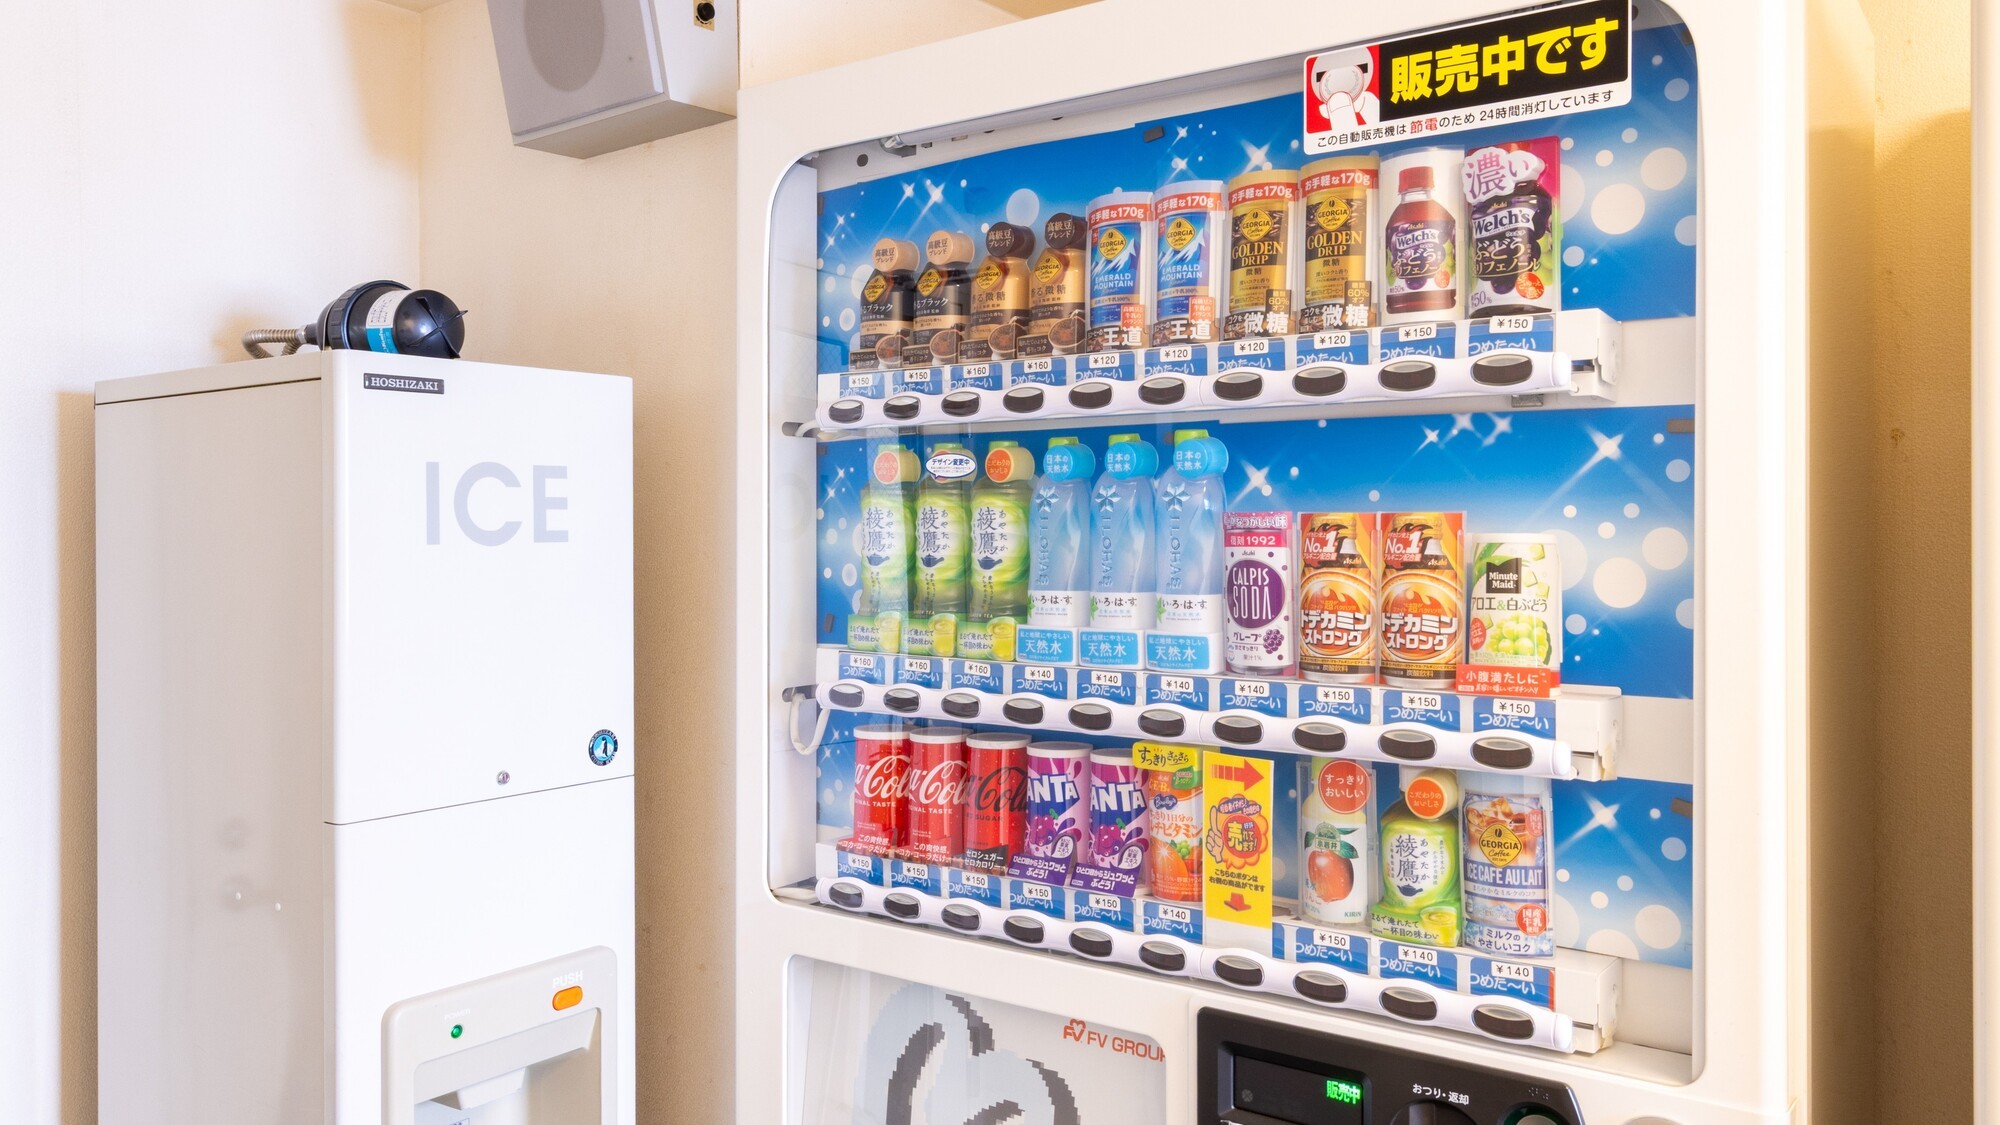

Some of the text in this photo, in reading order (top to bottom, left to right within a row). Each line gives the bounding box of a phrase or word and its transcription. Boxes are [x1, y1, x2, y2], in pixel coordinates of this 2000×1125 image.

[1390, 17, 1619, 104] 販売中です
[1317, 124, 1407, 148] この自動販売機は
[1480, 90, 1614, 122] 24時間消灯しています
[1305, 173, 1370, 190] お手軽な170g
[1465, 152, 1530, 199] 濃い
[1231, 186, 1293, 203] お手軽な170g
[1157, 195, 1214, 213] お手軽な170g
[1090, 206, 1144, 223] お手軽な170g
[1317, 208, 1348, 218] GEORGIA
[1242, 219, 1270, 229] GEORGIA
[1473, 209, 1531, 233] Welch's
[1167, 229, 1193, 239] GEORGIA
[1307, 230, 1363, 250] GOLDEN
[1396, 230, 1436, 247] Welch's
[1100, 239, 1125, 248] GEORGIA
[1475, 237, 1526, 261] ぶどう
[1232, 241, 1284, 260] GOLDEN
[1317, 245, 1347, 257] DRIP
[1241, 255, 1268, 267] DRIP
[1322, 257, 1340, 267] 微糖
[1162, 265, 1201, 274] EMERALD
[1095, 273, 1131, 283] EMERALD
[1160, 272, 1202, 282] MOUNTAIN
[1094, 280, 1134, 290] MOUNTAIN
[1348, 288, 1370, 297] 60%
[1268, 297, 1290, 305] 60%
[1322, 304, 1369, 327] 微糖
[1244, 311, 1289, 334] 微糖
[1497, 318, 1528, 329] ¥150
[1170, 319, 1211, 340] 王道
[1404, 326, 1432, 338] ¥150
[1103, 326, 1143, 346] 王道
[1319, 335, 1346, 345] ¥120
[1239, 341, 1265, 352] ¥120
[1164, 349, 1188, 358] ¥120
[1027, 361, 1049, 370] ¥160
[1092, 355, 1116, 365] ¥120
[909, 371, 928, 380] ¥150
[966, 366, 987, 376] ¥160
[371, 377, 439, 391] HOSHIZAKI
[851, 377, 870, 386] ¥150
[1046, 454, 1068, 464] 日本の
[1107, 453, 1130, 463] 日本の
[1175, 450, 1201, 461] 日本の
[931, 458, 970, 466] デザイン変更中
[1046, 463, 1069, 473] 天然水
[1107, 462, 1131, 472] 天然水
[1175, 460, 1202, 471] 天然水
[426, 461, 569, 547] ICE
[866, 507, 887, 552] 綾鷹
[885, 509, 895, 550] あやたか
[920, 506, 943, 555] 綾鷹
[940, 508, 951, 551] あやたか
[977, 506, 999, 555] 綾鷹
[998, 509, 1009, 552] あやたか
[1247, 535, 1276, 545] 1992
[1304, 530, 1337, 552] No.1
[1385, 531, 1421, 554] No.1
[1232, 567, 1270, 586] CALPIS
[1489, 571, 1518, 581] Minute
[1492, 580, 1515, 589] Maid
[1233, 585, 1272, 620] SODA
[1301, 610, 1372, 633] ドデカミン
[1381, 612, 1457, 635] ドデカミン
[1233, 631, 1262, 642] グレープ
[1305, 629, 1362, 647] ストロング
[1386, 633, 1448, 651] ストロング
[1025, 640, 1062, 655] 天然水
[1088, 642, 1127, 657] 天然水
[1155, 645, 1197, 662] 天然水
[853, 656, 872, 666] ¥160
[908, 661, 928, 671] ¥160
[968, 663, 988, 674] ¥160
[1030, 669, 1052, 679] ¥140
[1096, 674, 1119, 684] ¥140
[1466, 671, 1539, 685] 小腹満たしに
[1166, 680, 1190, 690] ¥140
[1239, 684, 1265, 695] ¥140
[1323, 690, 1350, 701] ¥150
[1408, 696, 1437, 707] ¥150
[1499, 702, 1530, 714] ¥150
[1138, 746, 1189, 767] すっきりさらさら
[1325, 773, 1364, 785] すっきり
[1325, 788, 1364, 799] おいしい
[1409, 791, 1442, 800] こだわりの
[1413, 800, 1440, 808] おいしさ
[1481, 839, 1520, 850] GEORGIA
[965, 849, 1004, 861] ゼロシュガー
[1395, 834, 1420, 884] 綾鷹
[1488, 849, 1511, 858] Coffee
[852, 857, 870, 868] ¥150
[964, 858, 1002, 870] ゼロカロリー
[1420, 839, 1430, 881] あやたか
[906, 866, 926, 877] ¥150
[1214, 868, 1259, 882] こちらのボタンは
[1505, 868, 1543, 886] AU LAIT
[965, 874, 986, 886] ¥150
[1090, 878, 1116, 891] ぶどう!
[1028, 887, 1049, 898] ¥150
[1095, 897, 1118, 908] ¥150
[1162, 908, 1187, 920] ¥140
[1371, 913, 1419, 929] まるで淹れたて
[1383, 926, 1440, 940] 一杯目の味わい
[1486, 928, 1521, 941] ミルクの
[1319, 932, 1347, 947] ¥150
[1478, 938, 1532, 953] やさしいコク
[1402, 948, 1433, 962] ¥140
[1496, 964, 1530, 978] ¥140
[552, 970, 584, 988] PUSH
[1087, 1030, 1108, 1048] FV
[1326, 1080, 1361, 1105] 販売中
[1412, 1083, 1470, 1105] おつり・返却
